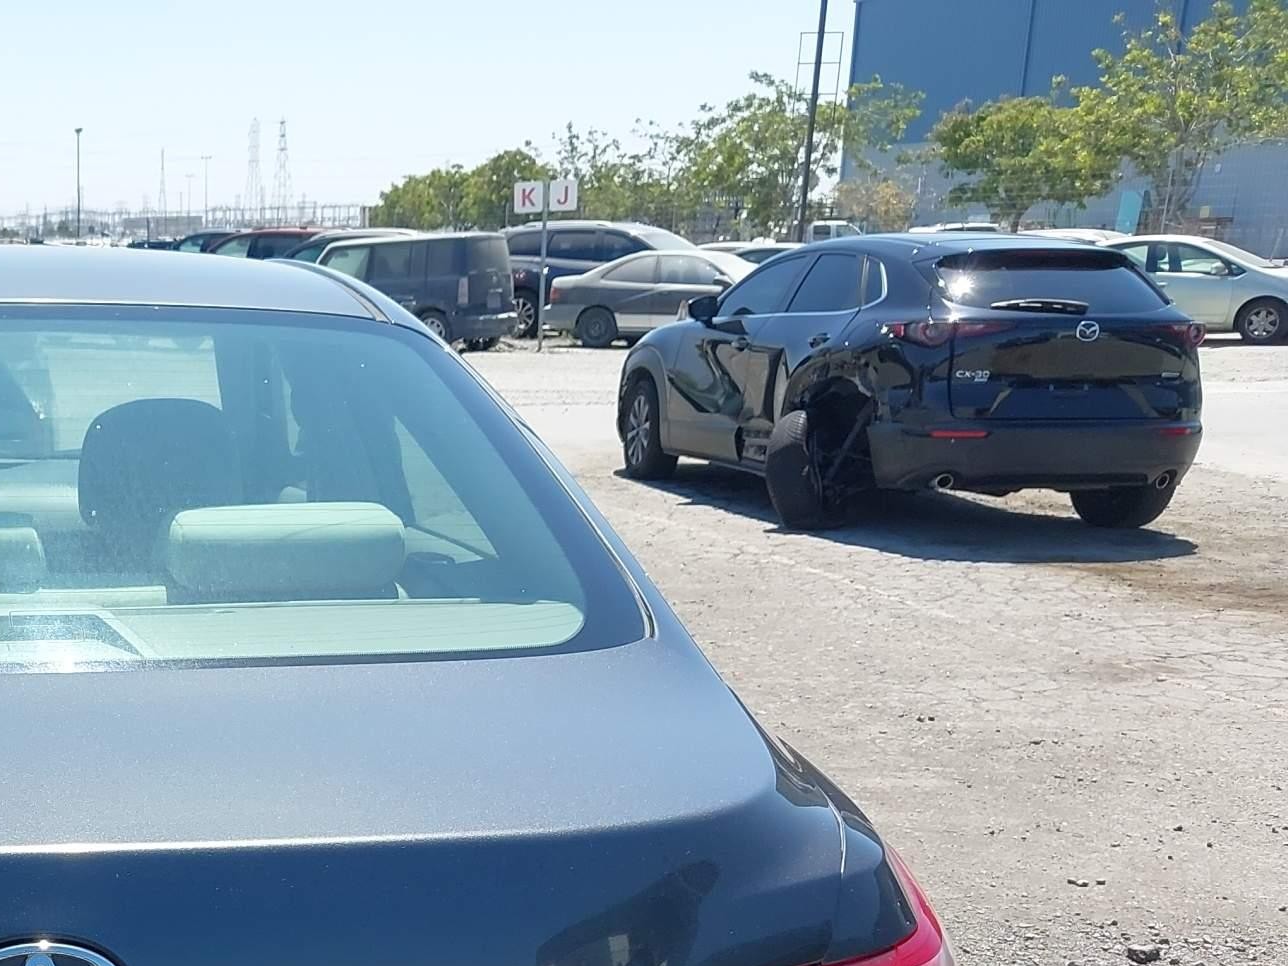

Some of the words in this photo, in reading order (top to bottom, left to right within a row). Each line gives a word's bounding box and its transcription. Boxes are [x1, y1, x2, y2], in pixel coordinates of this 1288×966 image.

[521, 187, 536, 208] K
[556, 185, 569, 206] J
[955, 370, 991, 378] CX-30
